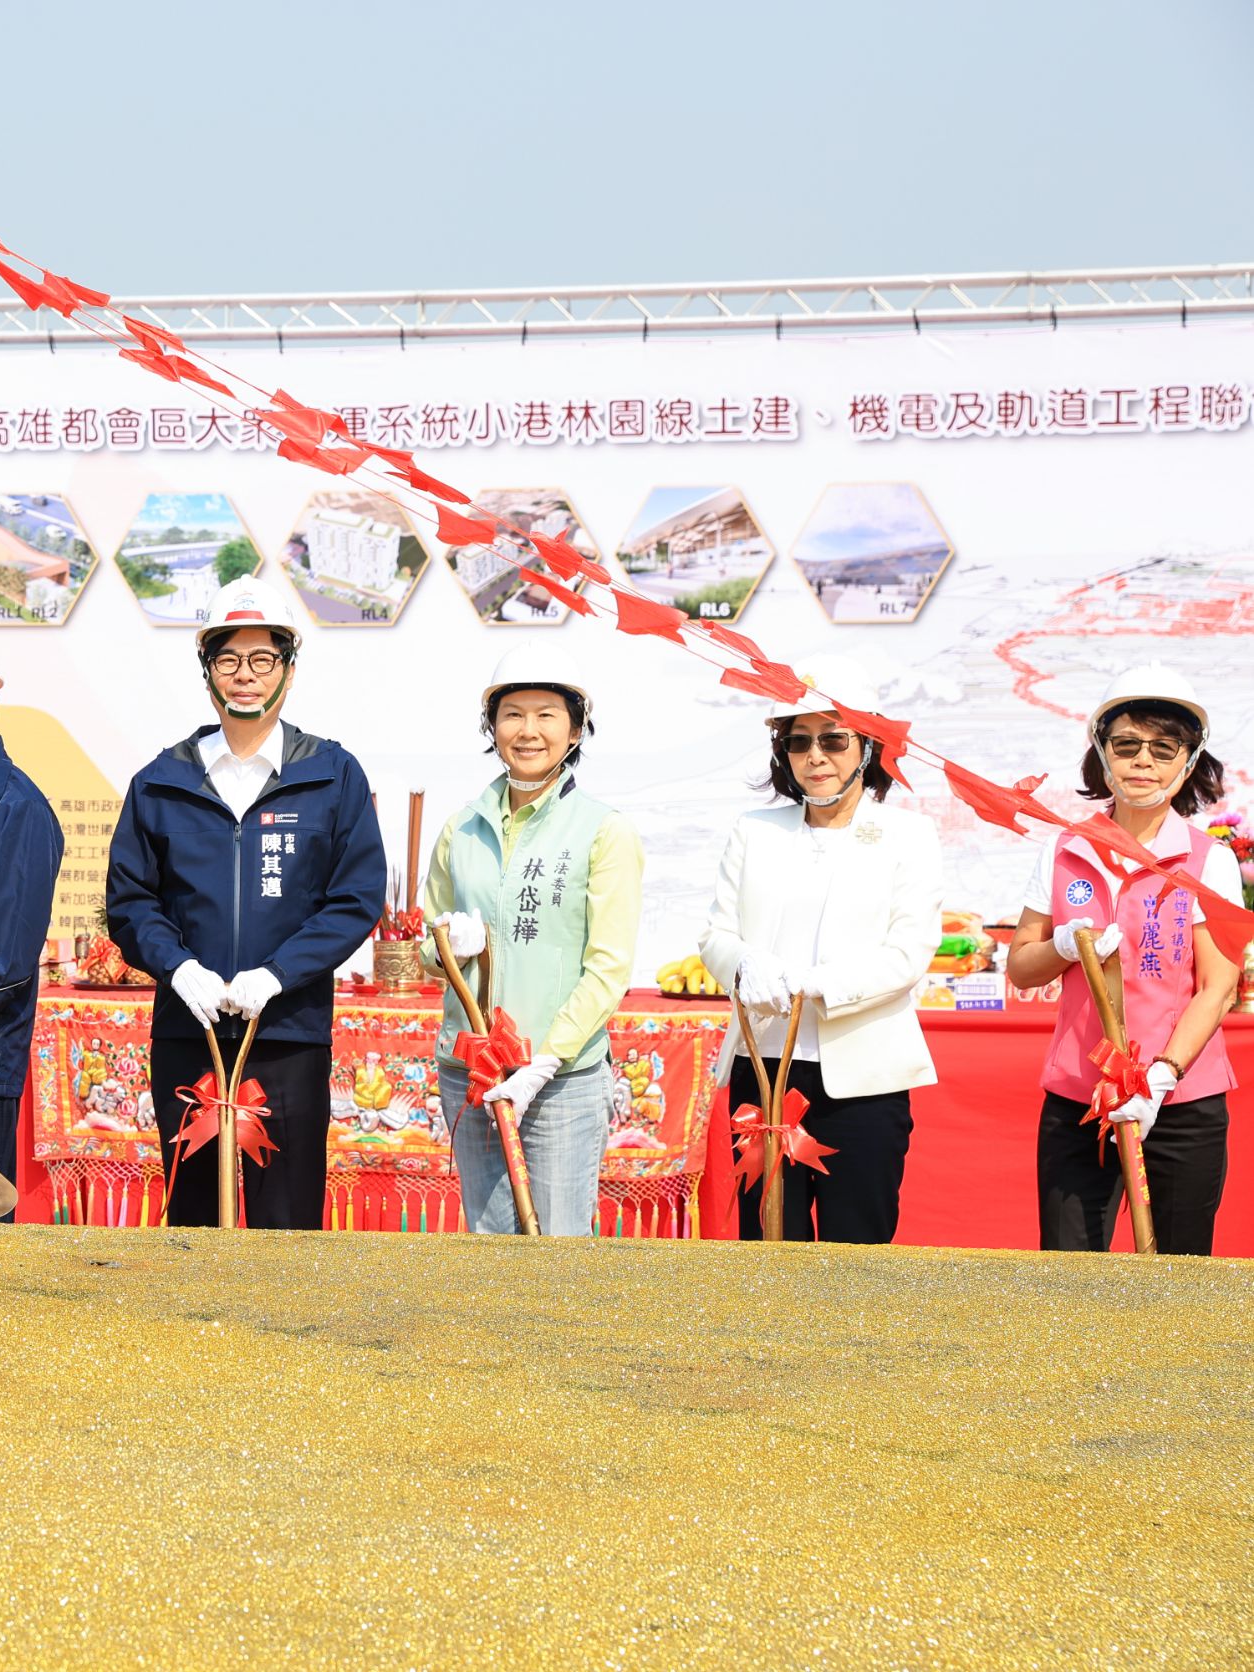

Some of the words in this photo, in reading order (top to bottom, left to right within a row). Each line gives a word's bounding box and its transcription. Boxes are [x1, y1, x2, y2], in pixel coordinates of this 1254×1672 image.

[32, 606, 58, 619] RL2
[361, 608, 388, 621] RL4
[699, 602, 731, 618] RL6
[880, 602, 910, 615] RL7
[284, 833, 295, 854] 市長
[260, 833, 282, 898] 陳其邁
[551, 849, 572, 908] 立法委員
[510, 858, 546, 946] 林岱樺
